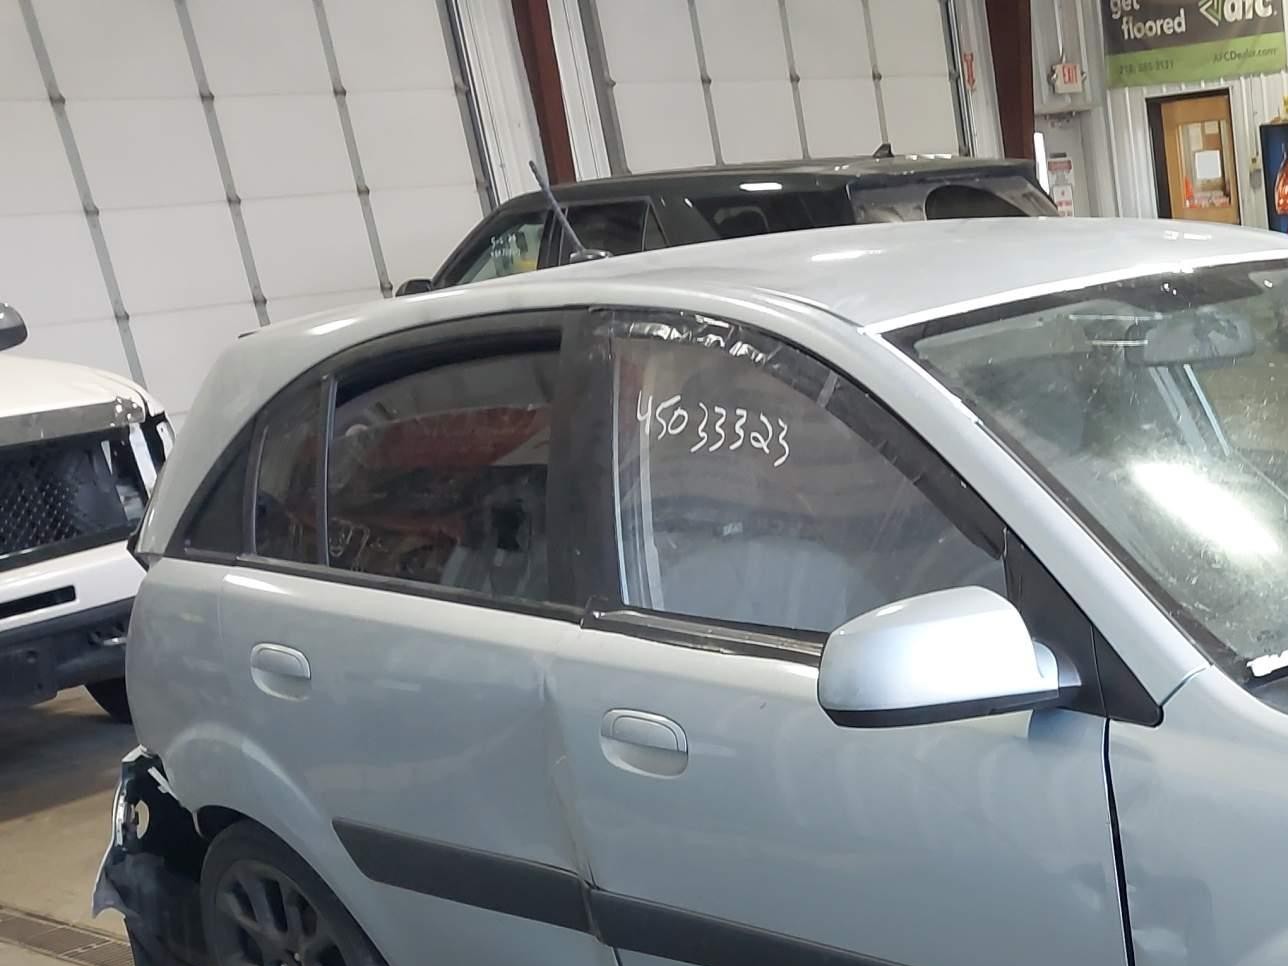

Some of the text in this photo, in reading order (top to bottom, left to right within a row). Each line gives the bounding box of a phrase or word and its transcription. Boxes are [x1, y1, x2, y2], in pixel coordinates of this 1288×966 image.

[1121, 8, 1186, 40] floored
[1062, 64, 1078, 84] EXIT
[636, 390, 790, 467] 45033323
